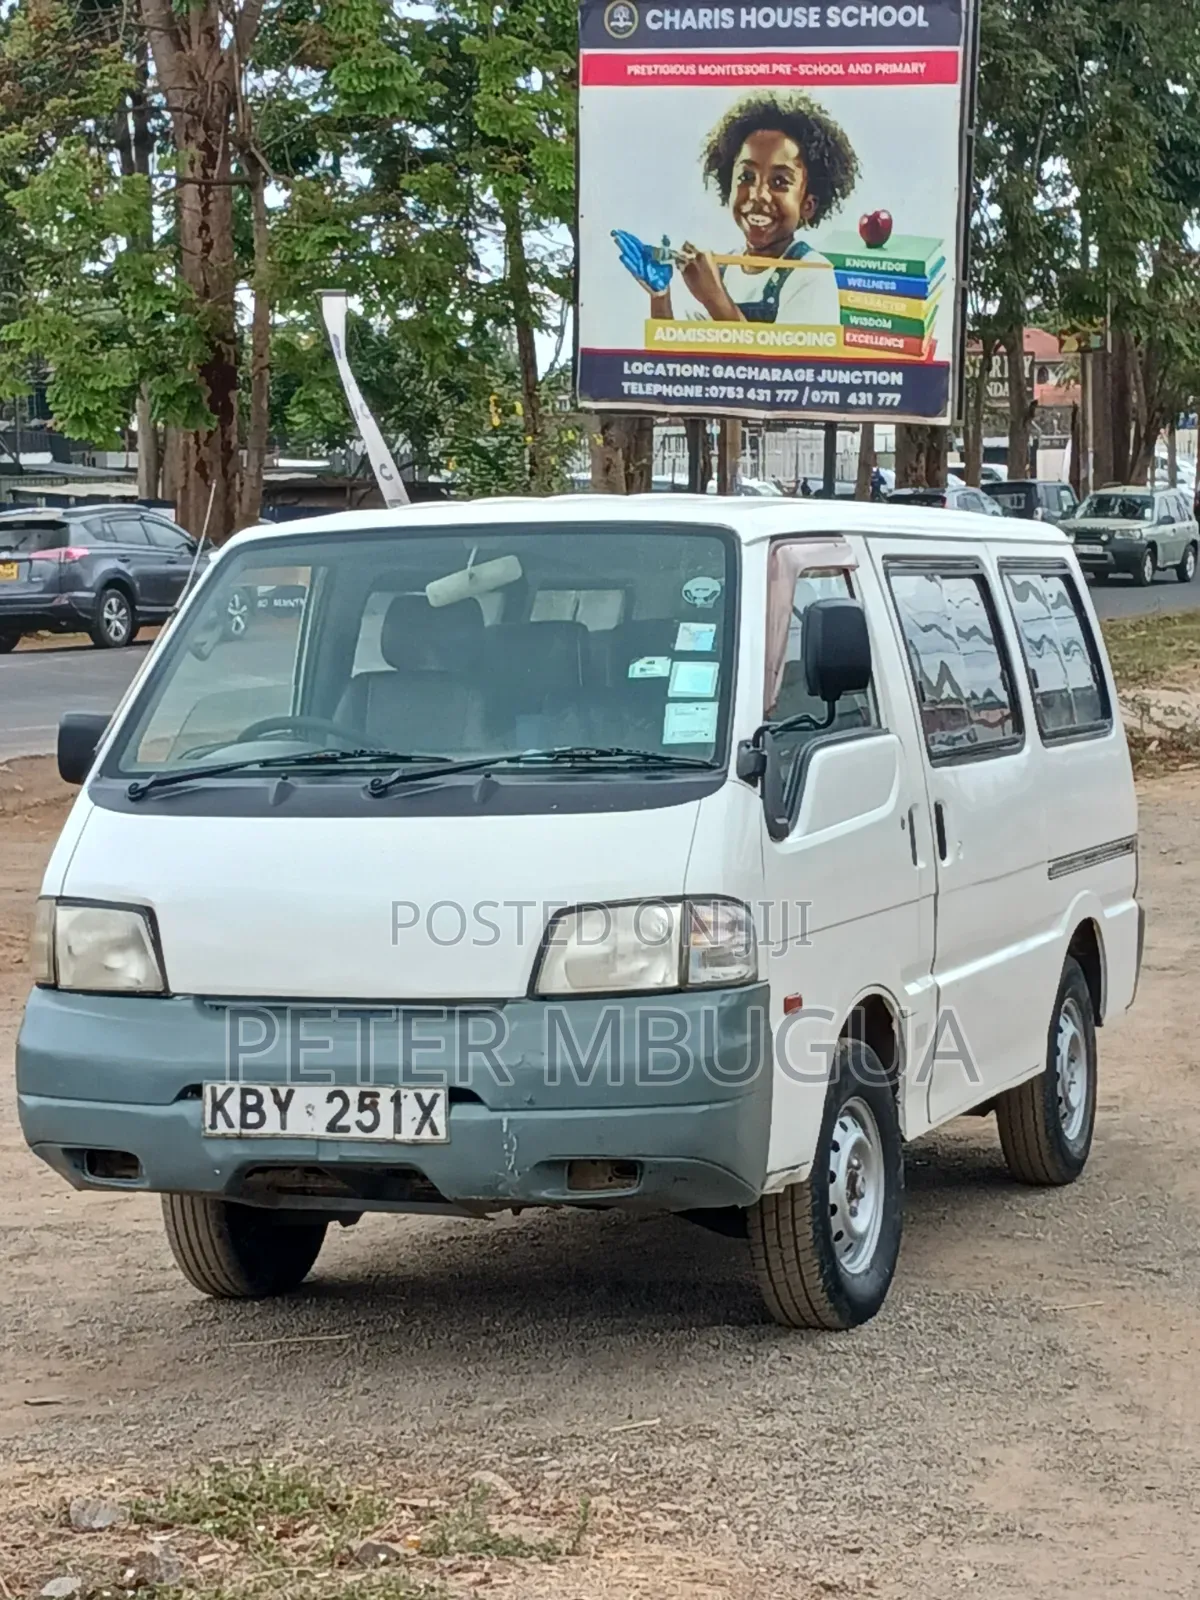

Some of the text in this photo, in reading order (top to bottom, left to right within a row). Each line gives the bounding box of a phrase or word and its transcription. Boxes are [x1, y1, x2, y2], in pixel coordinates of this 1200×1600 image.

[645, 4, 929, 31] CHARIS HOUSE SCHOOL
[626, 64, 697, 76] PRESTIGIOUS
[847, 62, 872, 75] AND
[874, 61, 927, 76] PRIMARY
[845, 257, 908, 272] KNOWLEDGE
[847, 277, 897, 290] WELLNESS
[849, 314, 892, 329] WISDOM
[654, 326, 837, 347] ADMISSIONS ONGOING
[845, 332, 905, 349] EXCELLENCE
[623, 361, 904, 386] LOCATION: GACHARAGE JUNCTION
[746, 388, 771, 402] 431
[775, 389, 799, 402] 777
[847, 391, 873, 405] 431
[877, 392, 902, 406] 777
[209, 1086, 440, 1136] KBY 251X
